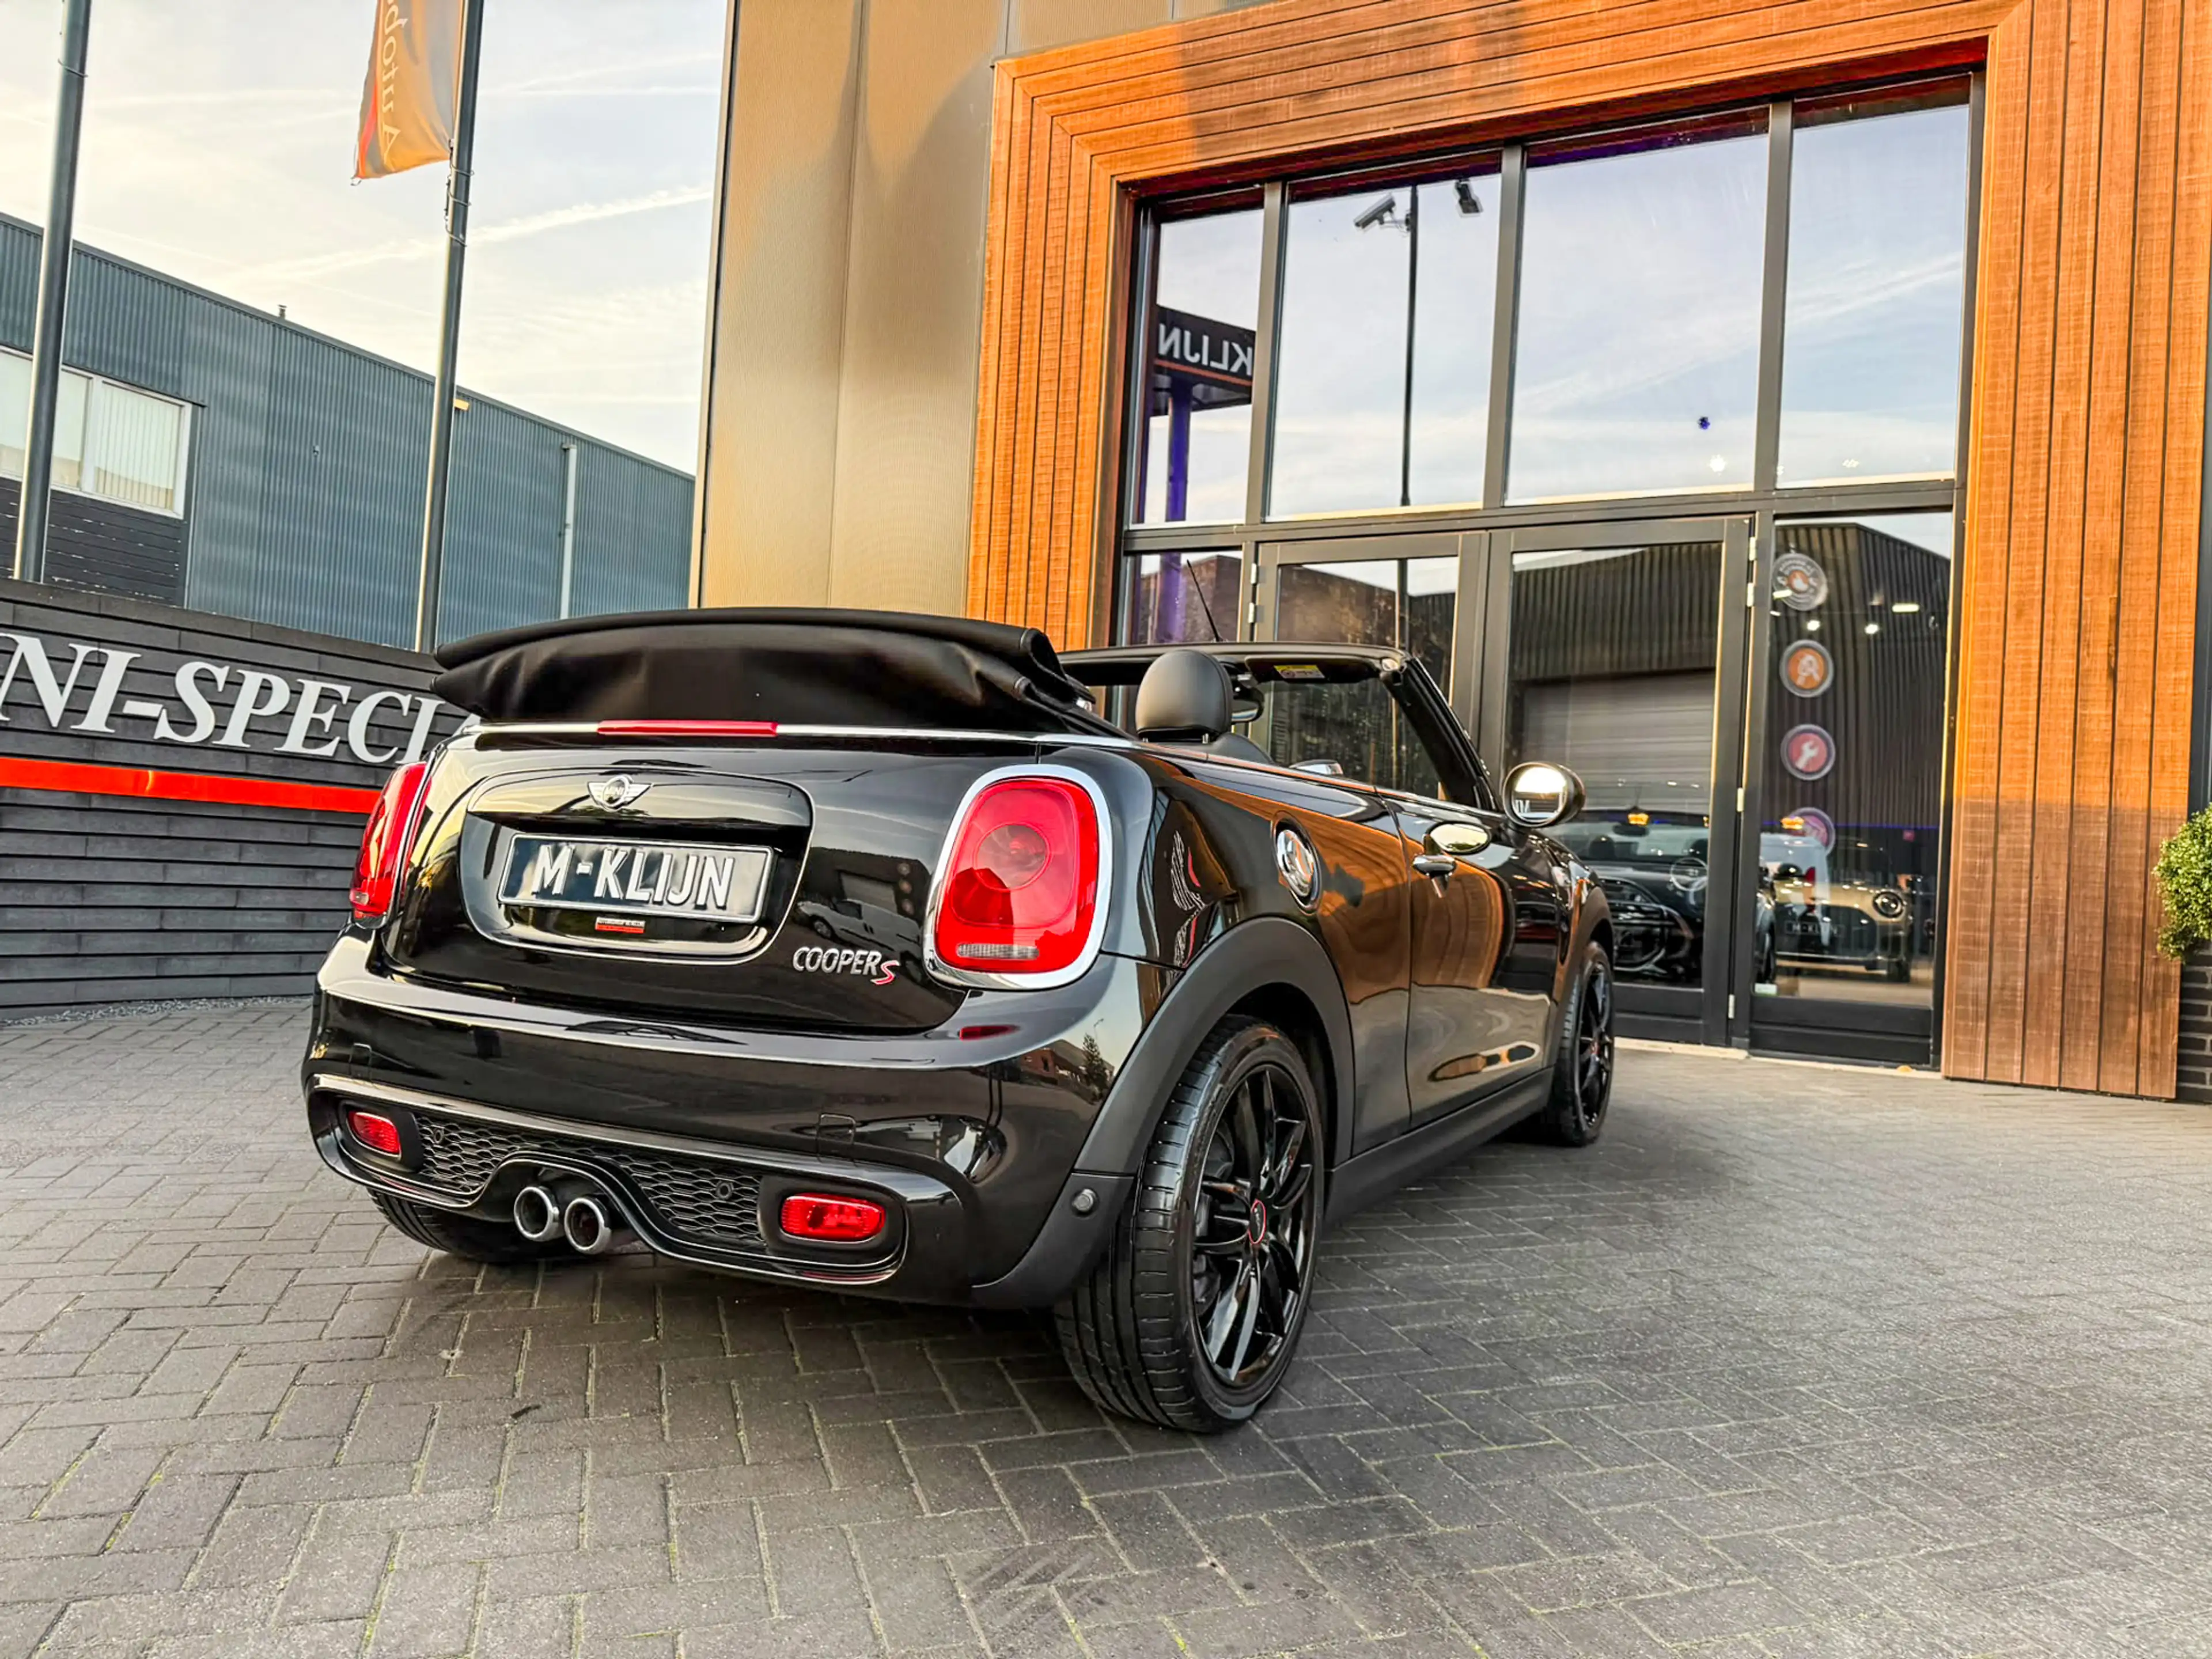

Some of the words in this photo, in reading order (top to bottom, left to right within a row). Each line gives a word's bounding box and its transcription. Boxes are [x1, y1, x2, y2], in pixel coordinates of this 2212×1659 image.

[0, 632, 482, 764] NI-SPECI
[531, 844, 734, 909] M-KLIJN
[793, 946, 882, 976] COOPER
[870, 960, 901, 985] S
